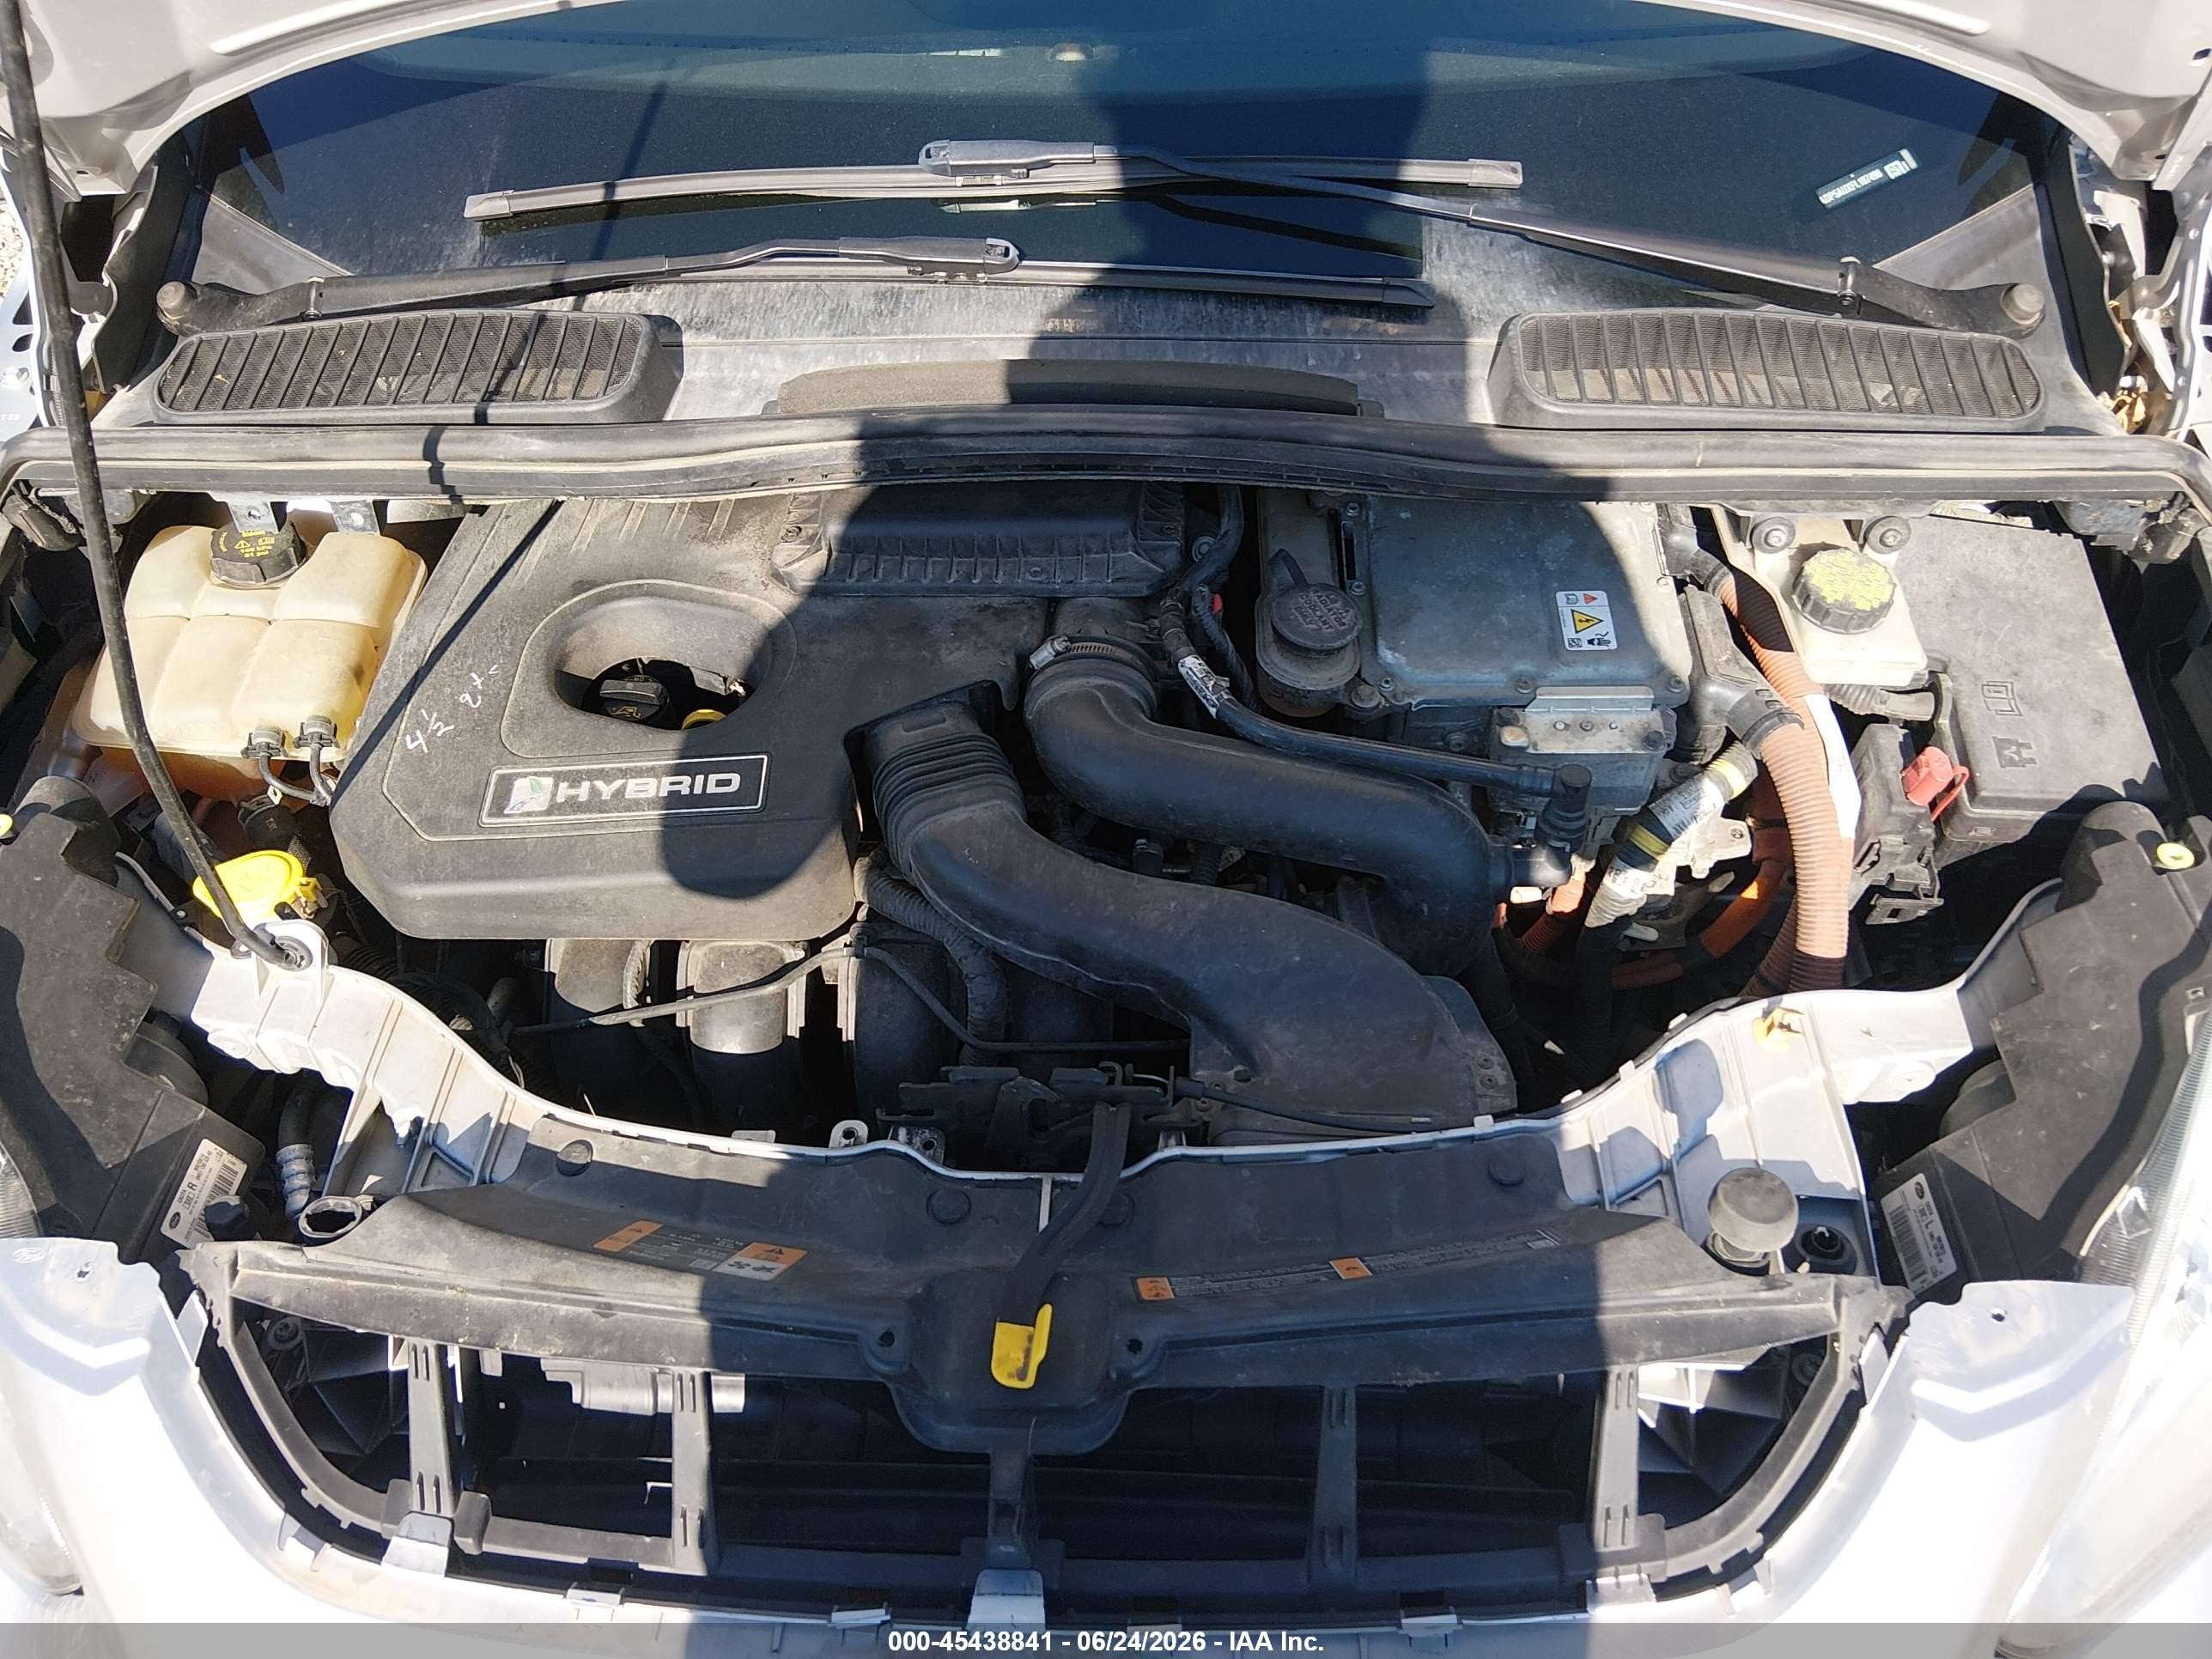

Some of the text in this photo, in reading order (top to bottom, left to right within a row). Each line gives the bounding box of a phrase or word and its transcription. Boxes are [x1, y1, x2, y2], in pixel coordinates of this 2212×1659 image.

[1298, 592, 1334, 631] COOLANT
[556, 772, 741, 804] HYBRID
[186, 1182, 198, 1192] R
